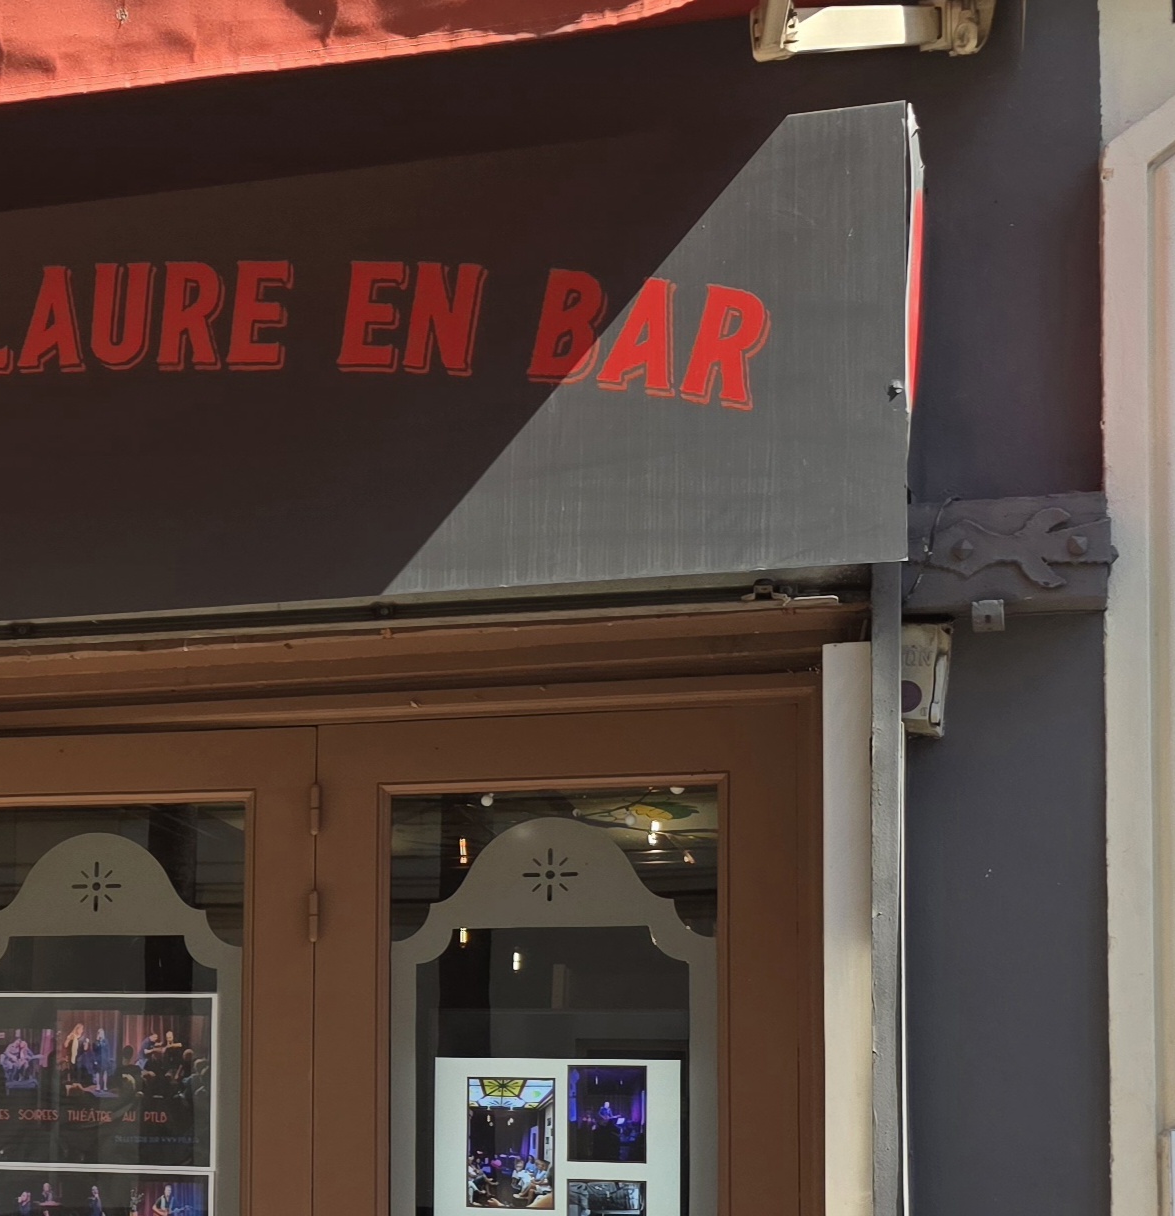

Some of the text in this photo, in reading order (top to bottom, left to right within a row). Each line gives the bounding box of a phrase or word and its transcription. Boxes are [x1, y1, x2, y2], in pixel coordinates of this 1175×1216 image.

[337, 259, 488, 376] EN
[526, 267, 771, 412] BAR
[122, 1111, 136, 1122] AU
[143, 1111, 168, 1123] PTLB
